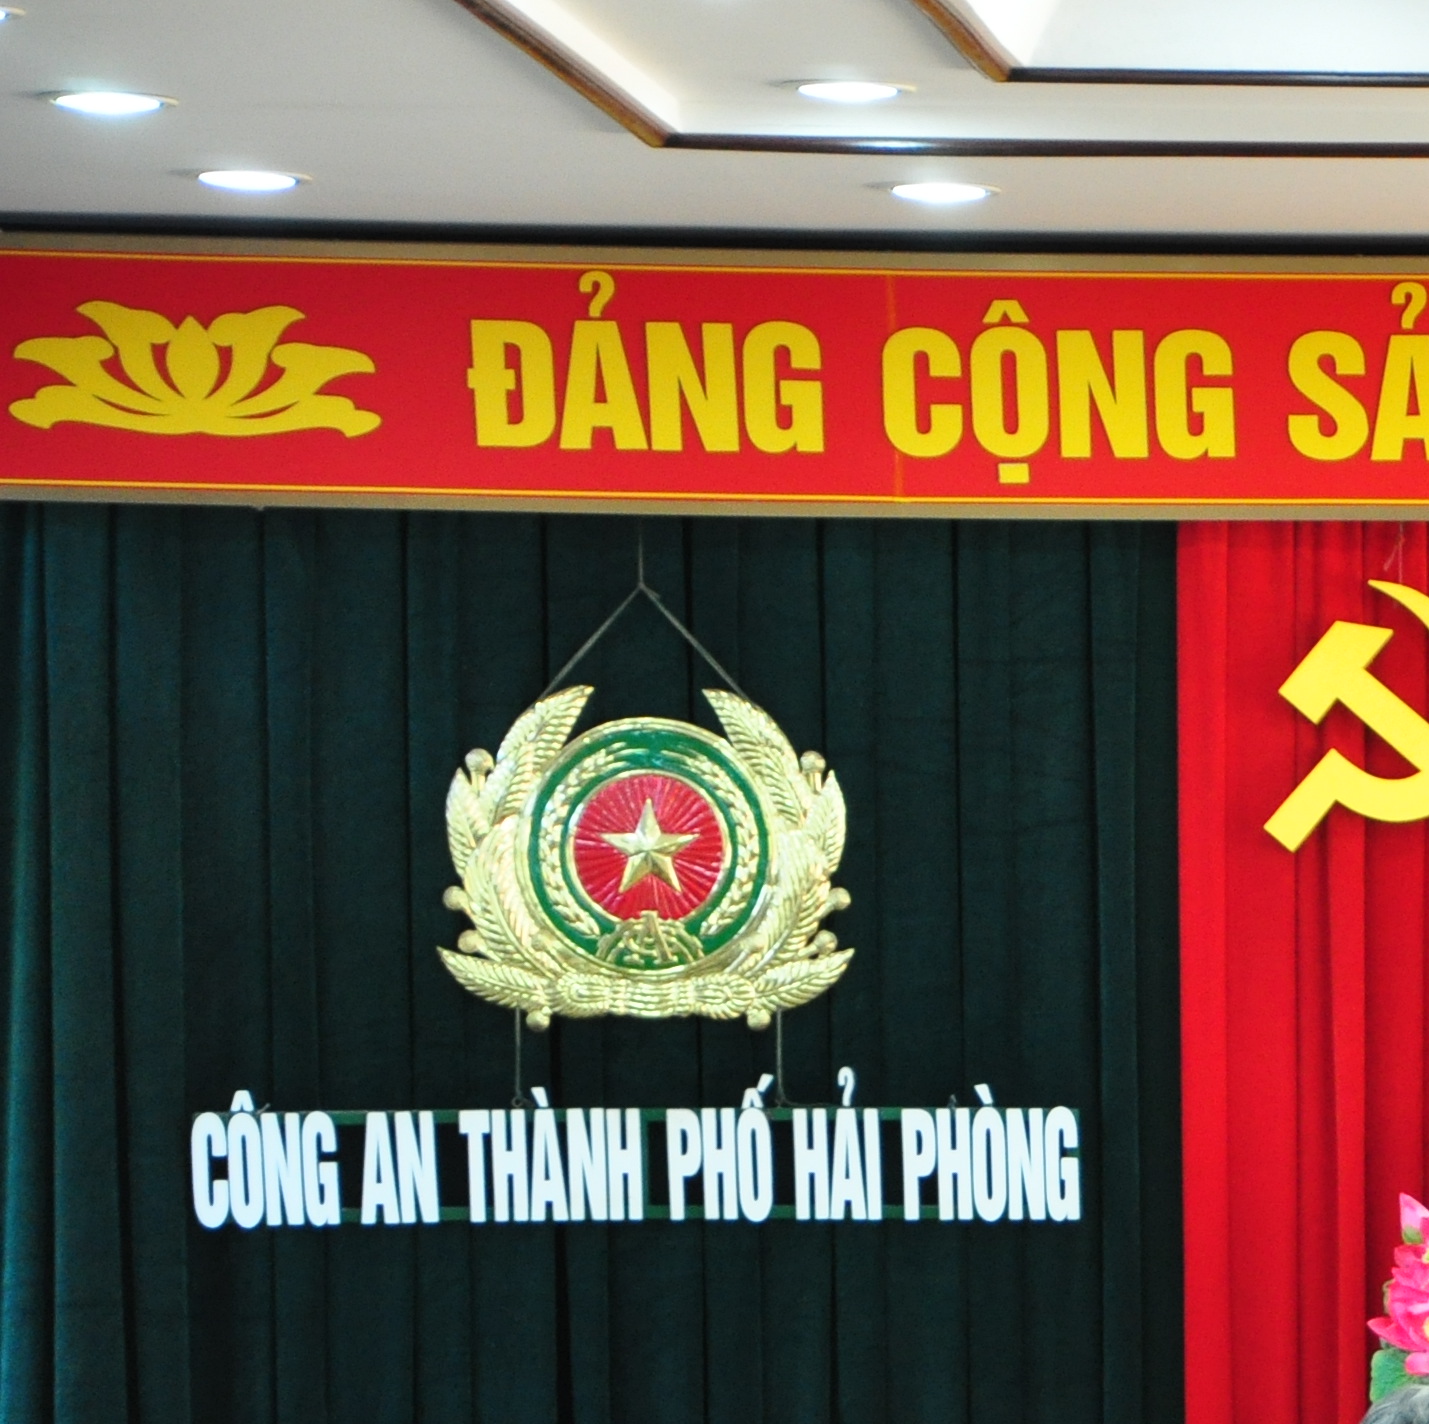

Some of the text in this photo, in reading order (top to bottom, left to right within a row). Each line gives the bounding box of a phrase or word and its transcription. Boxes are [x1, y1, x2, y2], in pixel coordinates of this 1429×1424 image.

[468, 271, 825, 455] ĐẢNG
[882, 300, 1236, 485] CỘNG
[191, 1067, 1080, 1228] CÔNG AN THÀNH PHỐ HẢI PHÒNG
